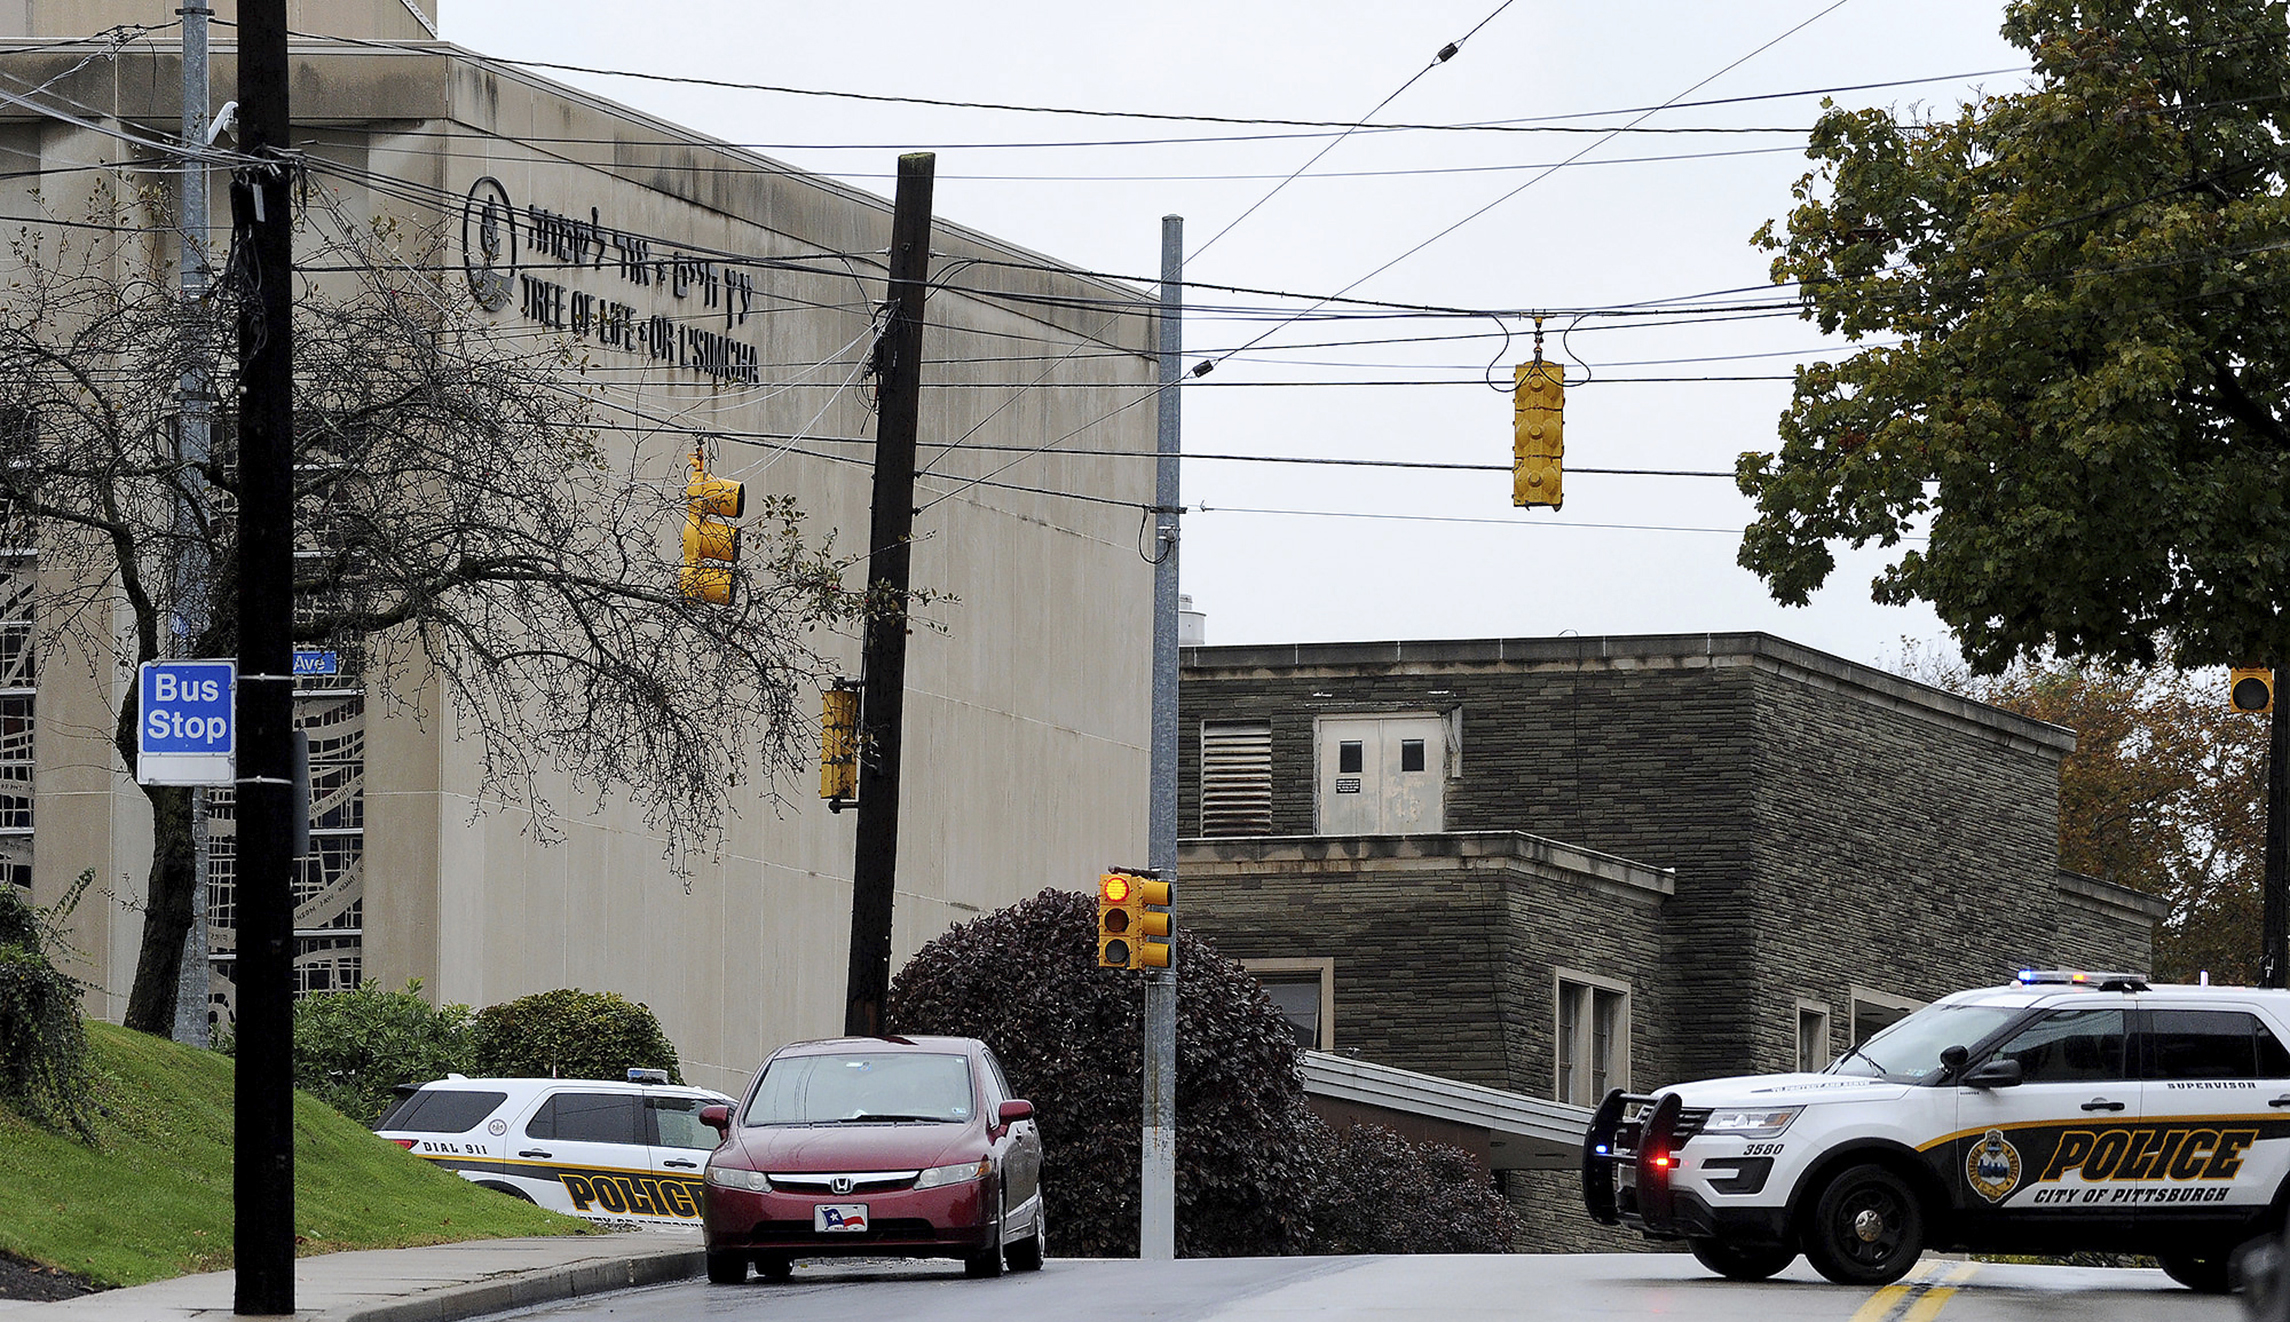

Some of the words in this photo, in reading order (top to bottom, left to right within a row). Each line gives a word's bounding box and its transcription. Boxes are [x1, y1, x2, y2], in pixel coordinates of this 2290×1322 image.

[520, 273, 566, 329] TREE
[571, 290, 595, 337] OF
[600, 299, 637, 350] LIFE
[650, 315, 675, 362] OR
[679, 322, 760, 383] L'SIMCHA
[293, 655, 325, 671] Ave
[155, 673, 219, 702] Bus
[148, 709, 227, 744] Stop
[423, 1142, 459, 1153] DIAL
[465, 1144, 487, 1154] 911
[1743, 1144, 1785, 1155] 3580
[2039, 1129, 2259, 1182] POLICE
[2034, 1188, 2079, 1203] CITY
[2084, 1189, 2108, 1203] OF
[2112, 1187, 2230, 1202] PITTSBURGH
